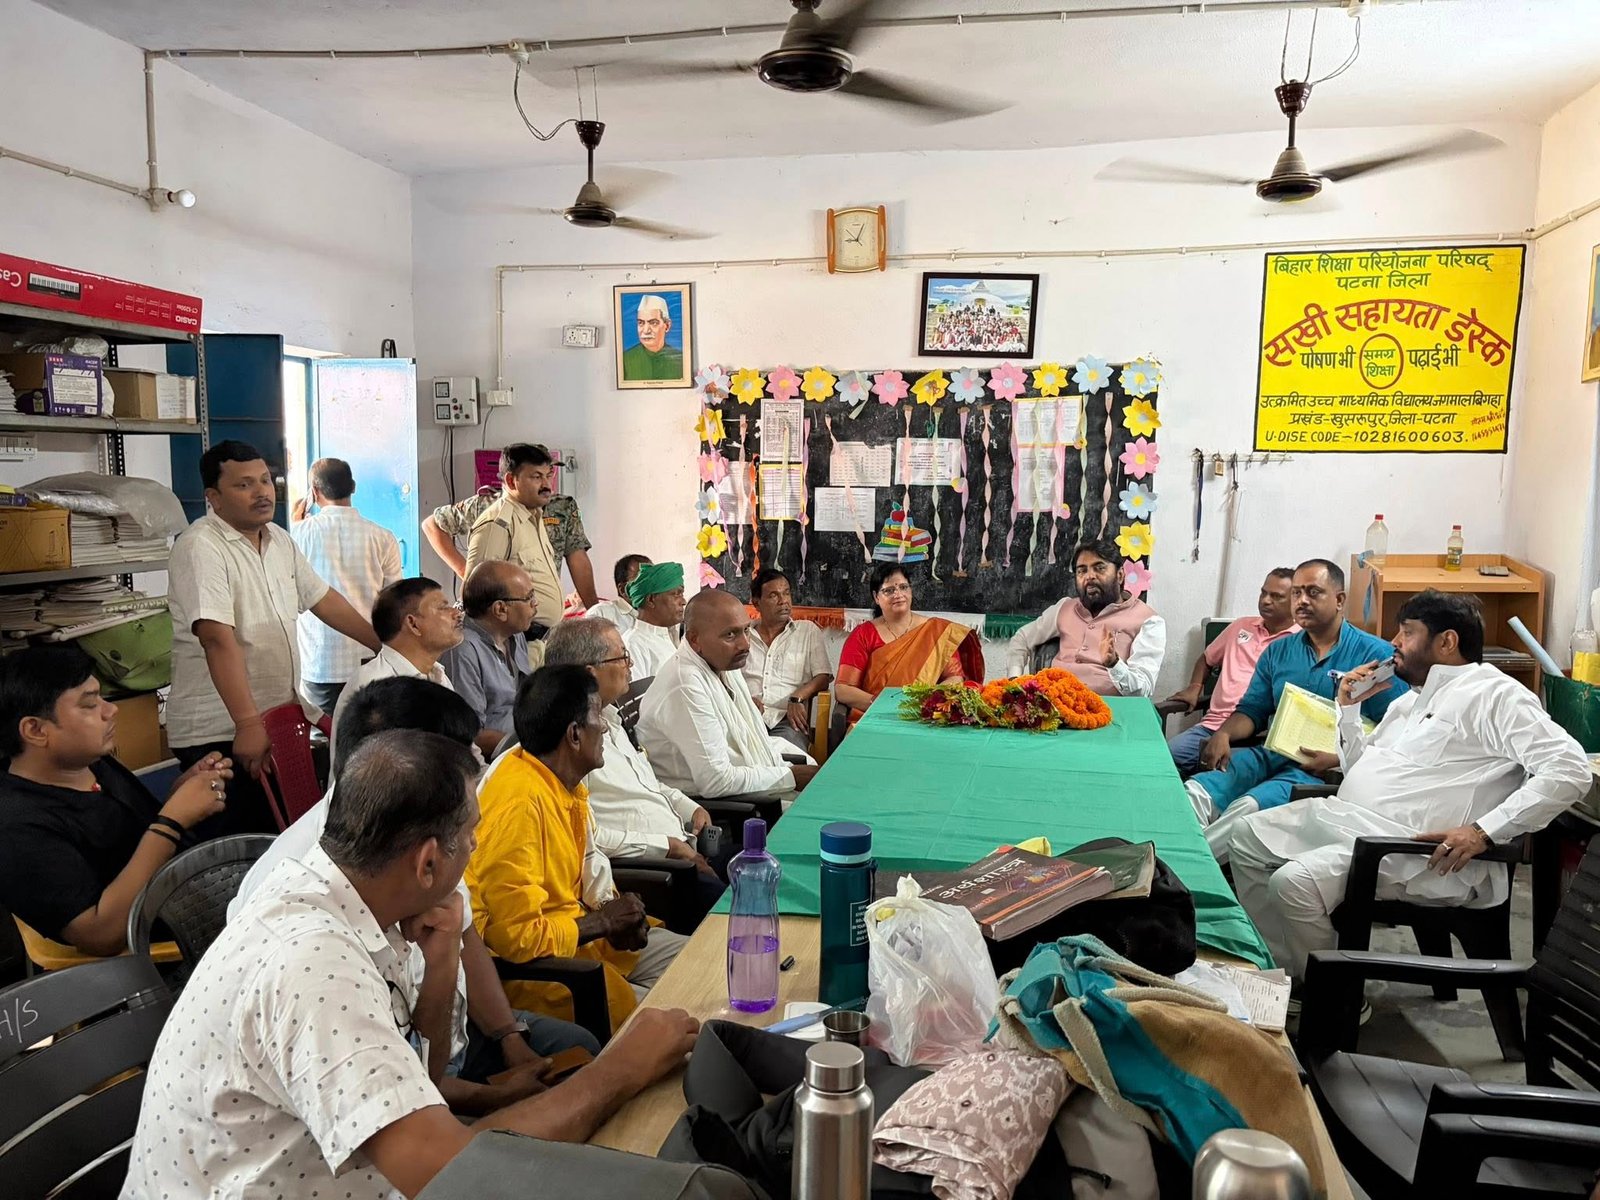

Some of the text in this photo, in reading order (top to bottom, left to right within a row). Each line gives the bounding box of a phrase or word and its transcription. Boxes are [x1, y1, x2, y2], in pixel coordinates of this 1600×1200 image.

[1272, 256, 1313, 276] बिहार
[1316, 252, 1353, 273] शिक्षा
[1357, 251, 1432, 272] परियोजना
[1335, 270, 1431, 290] पटना जिला
[175, 315, 198, 326] CASIO
[1264, 299, 1511, 366] सखी सहायता डेस्क
[1338, 345, 1356, 368] भी
[1364, 348, 1396, 361] समग्र
[1442, 344, 1461, 367] भी
[1365, 362, 1396, 377] शिक्षा
[1307, 396, 1338, 407] उच्च
[1339, 391, 1390, 407] माध्यमिक
[1391, 391, 1434, 407] विद्यालय
[938, 857, 1026, 899] अर्थशास्त्र
